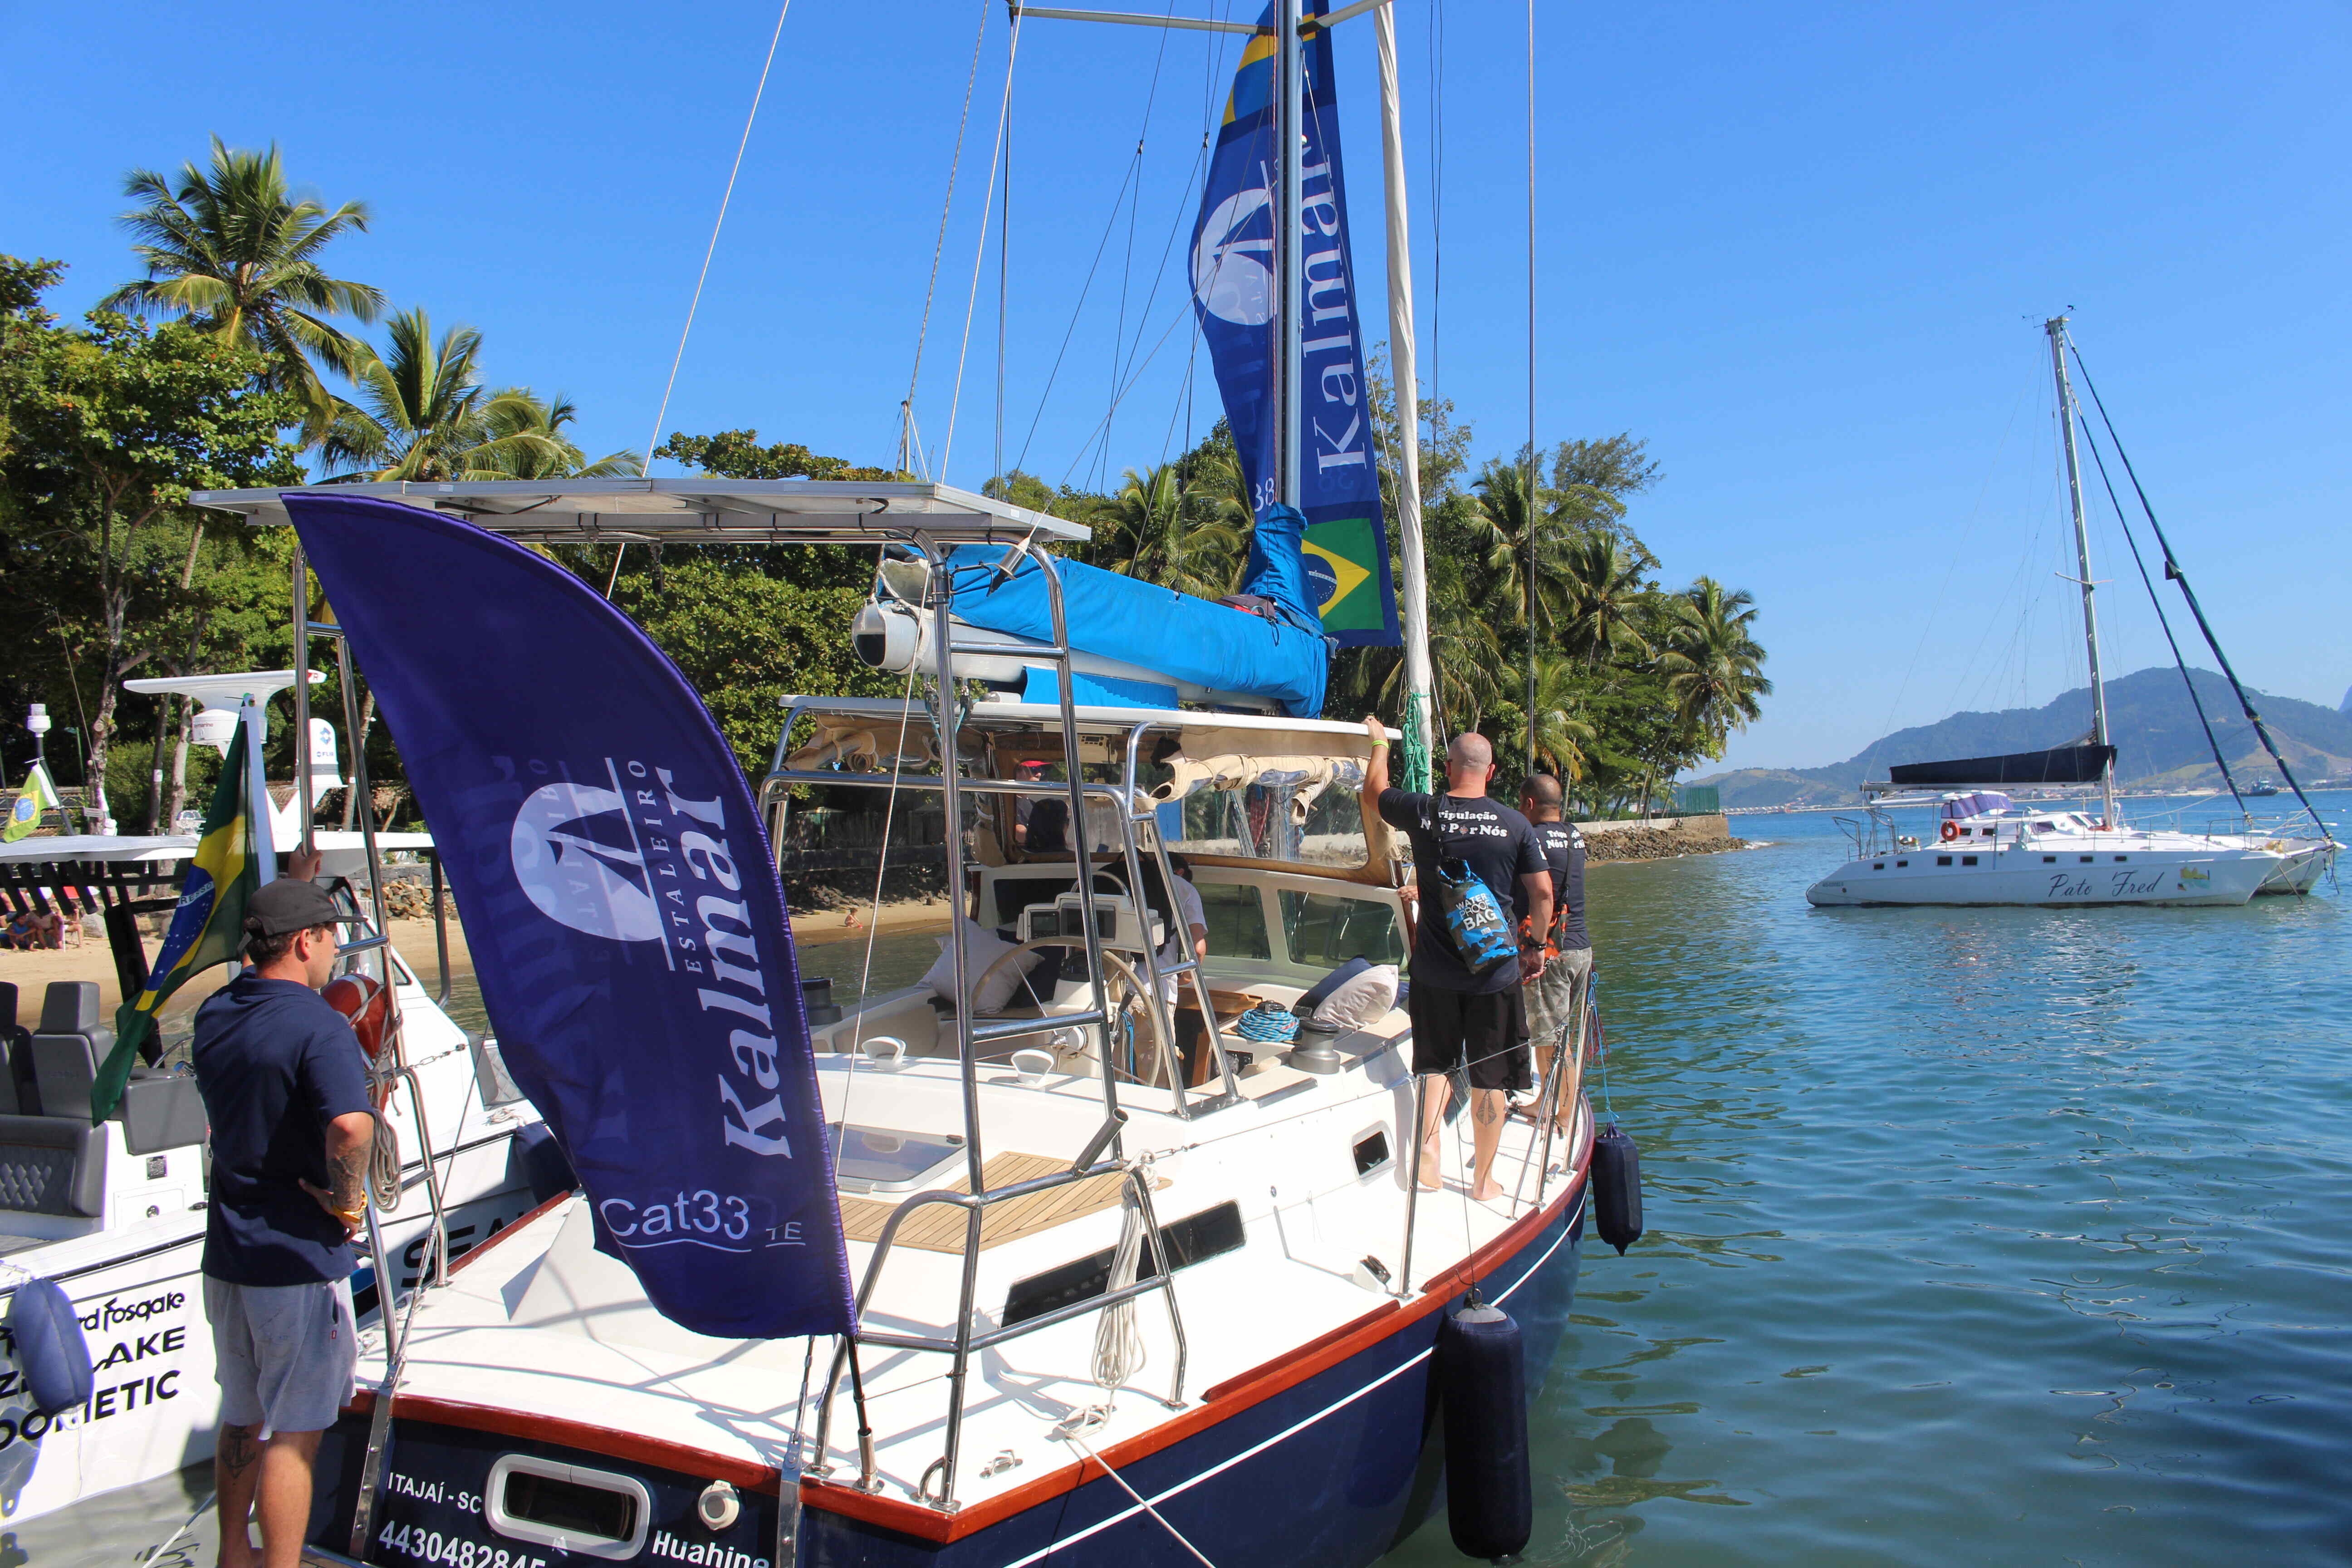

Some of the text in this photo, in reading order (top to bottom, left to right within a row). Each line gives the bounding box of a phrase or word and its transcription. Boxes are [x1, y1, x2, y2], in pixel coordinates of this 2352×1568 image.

[1302, 145, 1367, 475] Kalmar
[1437, 810, 1498, 821] ripulação
[1479, 824, 1508, 837] Nós
[628, 760, 702, 974] ESTALEIRO
[2048, 871, 2165, 897] Pato Fred
[1455, 893, 1487, 910] WATER
[1459, 900, 1491, 920] PROOF
[1463, 909, 1498, 931] BAG
[656, 765, 792, 1159] Kalmar
[600, 1190, 750, 1240] Cat33
[388, 1472, 445, 1504] ITAJAÍ
[457, 1491, 482, 1514] SC
